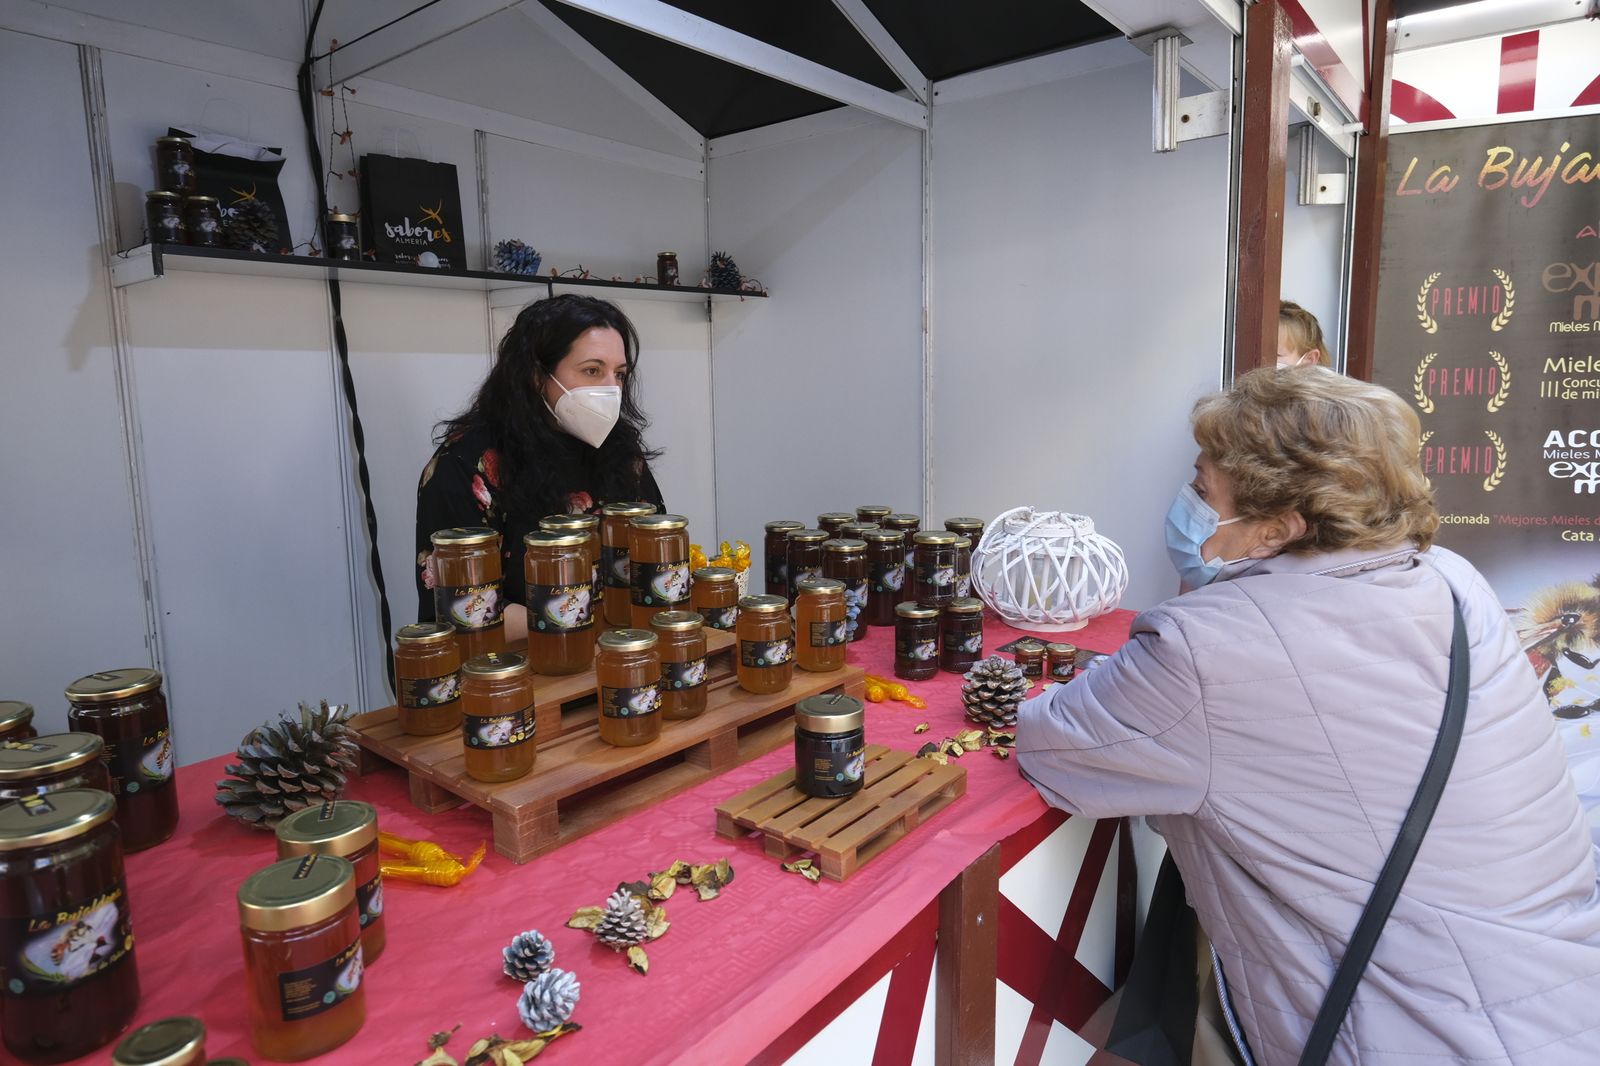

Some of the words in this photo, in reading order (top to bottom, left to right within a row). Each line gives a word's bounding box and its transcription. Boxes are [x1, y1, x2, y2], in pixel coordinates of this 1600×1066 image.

[1396, 157, 1459, 196] La
[1478, 141, 1600, 208] Buja
[385, 216, 452, 243] sabores
[1432, 285, 1500, 316] PREMIO
[1428, 367, 1496, 396] PREMIO
[1541, 380, 1558, 398] III
[1561, 388, 1578, 399] de
[1425, 447, 1492, 475] PREMIO
[1543, 449, 1590, 459] Mieles
[1439, 513, 1490, 524] ccionada
[1551, 514, 1590, 525] Mieles
[1561, 530, 1594, 542] Cata
